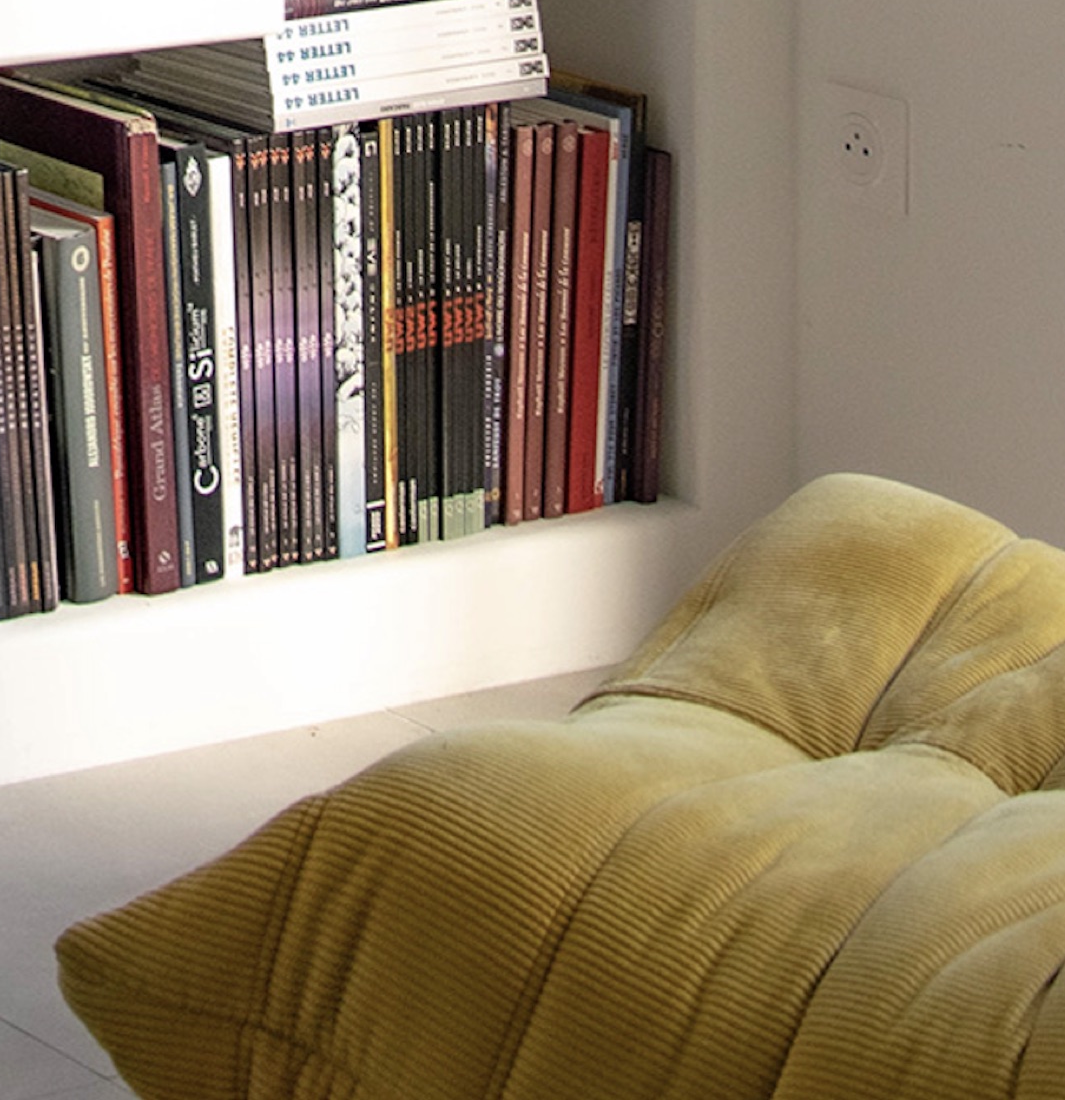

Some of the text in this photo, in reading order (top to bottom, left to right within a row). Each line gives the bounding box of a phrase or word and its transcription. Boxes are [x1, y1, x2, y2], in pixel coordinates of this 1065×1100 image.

[298, 18, 349, 38] LETTER
[276, 41, 351, 63] LETTER 44
[281, 64, 356, 86] LETTER 44
[285, 87, 360, 110] LETTER 44
[81, 353, 99, 468] ALEJANDRO JODOROWSKY
[149, 385, 164, 434] Atlas
[151, 441, 167, 501] Grand
[193, 417, 220, 495] Carbone
